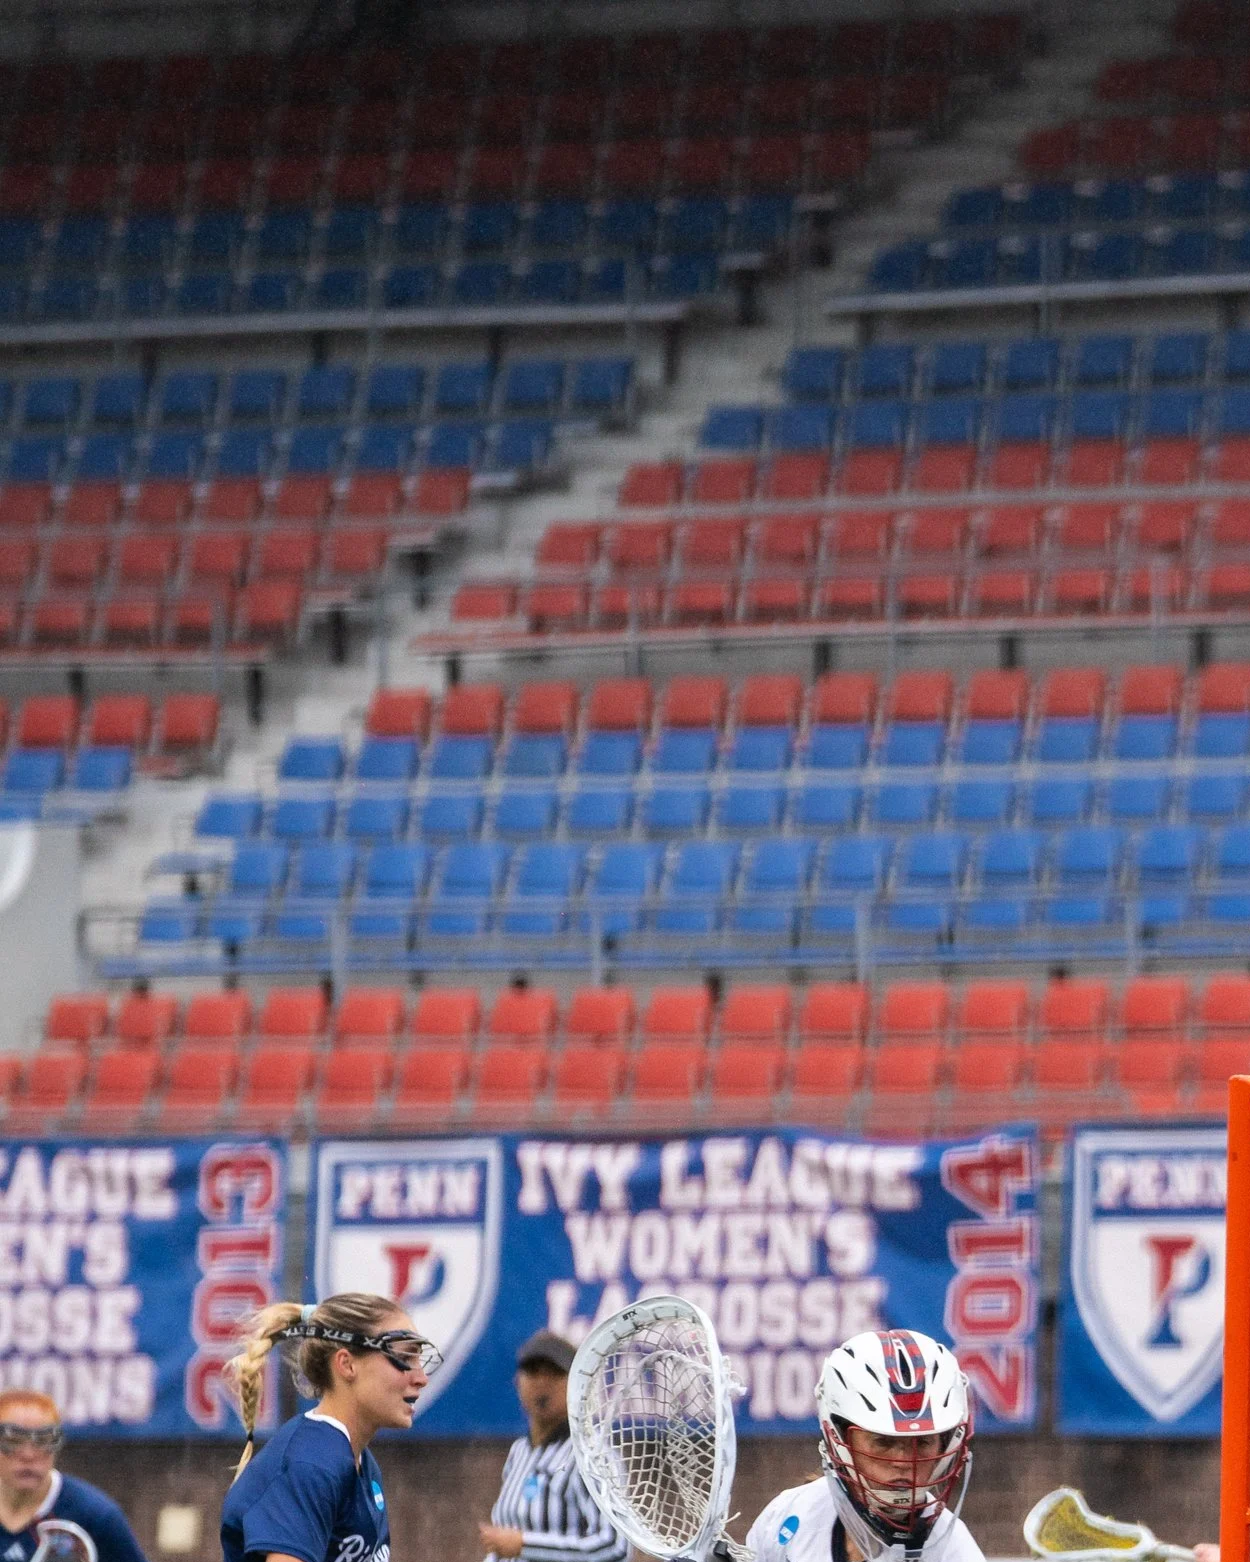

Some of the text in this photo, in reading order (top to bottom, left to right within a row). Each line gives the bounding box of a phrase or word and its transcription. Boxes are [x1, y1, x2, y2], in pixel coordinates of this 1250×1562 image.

[0, 1146, 176, 1220] AGUE
[340, 1160, 480, 1220] PENN
[516, 1136, 924, 1214] IVY LEAGUE
[564, 1207, 878, 1284] WOMEN'S
[940, 1135, 1038, 1424] 2014
[322, 1328, 353, 1342] STX
[622, 1309, 638, 1321] STX
